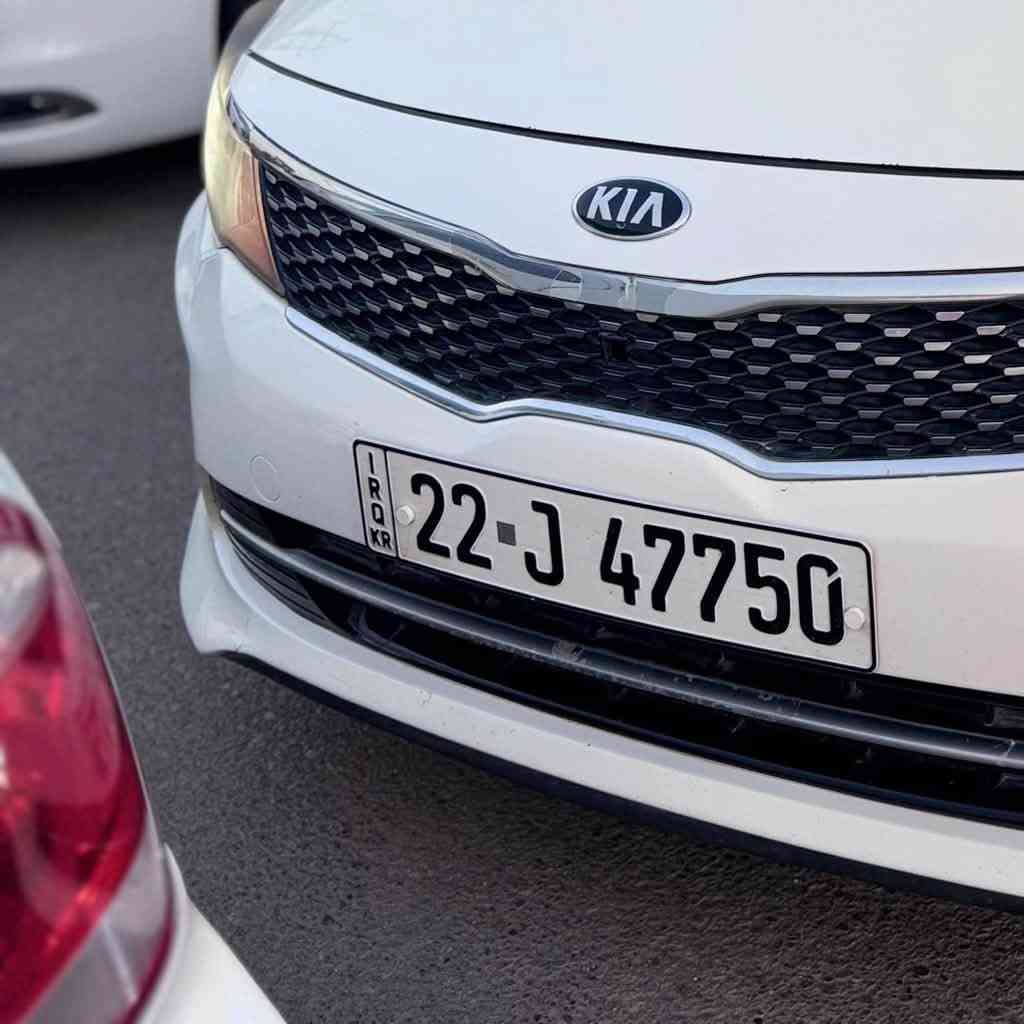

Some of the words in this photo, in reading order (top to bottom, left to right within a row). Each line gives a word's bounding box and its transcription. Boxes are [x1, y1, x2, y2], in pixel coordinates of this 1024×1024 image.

[586, 186, 664, 227] KIA
[367, 451, 385, 526] IRQ
[369, 527, 393, 550] KR
[411, 472, 492, 570] 22
[523, 500, 564, 587] J
[599, 516, 846, 646] 47750
